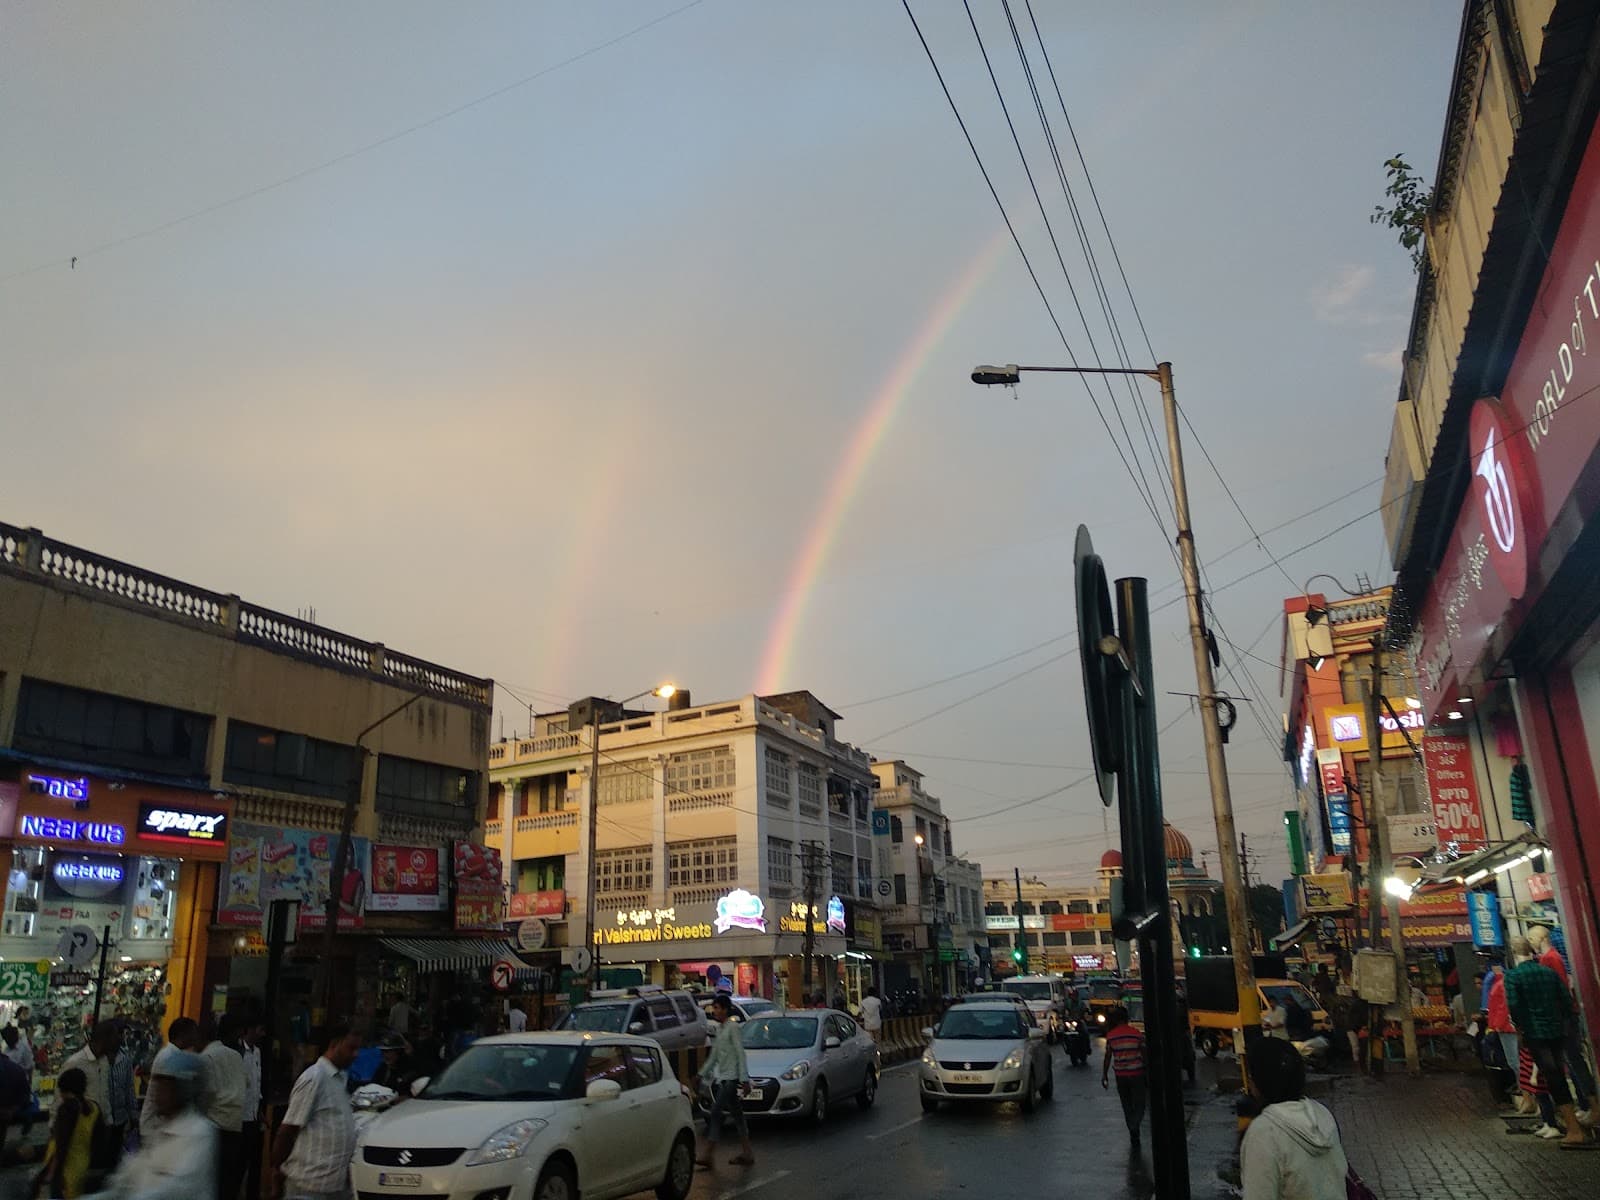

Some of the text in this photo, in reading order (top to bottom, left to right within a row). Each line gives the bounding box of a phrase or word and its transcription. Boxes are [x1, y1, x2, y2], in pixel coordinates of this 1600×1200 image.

[1526, 260, 1600, 451] WORLD of T
[1434, 802, 1480, 829] 50%
[604, 924, 661, 944] Vaishnavi
[663, 922, 712, 940] Sweets
